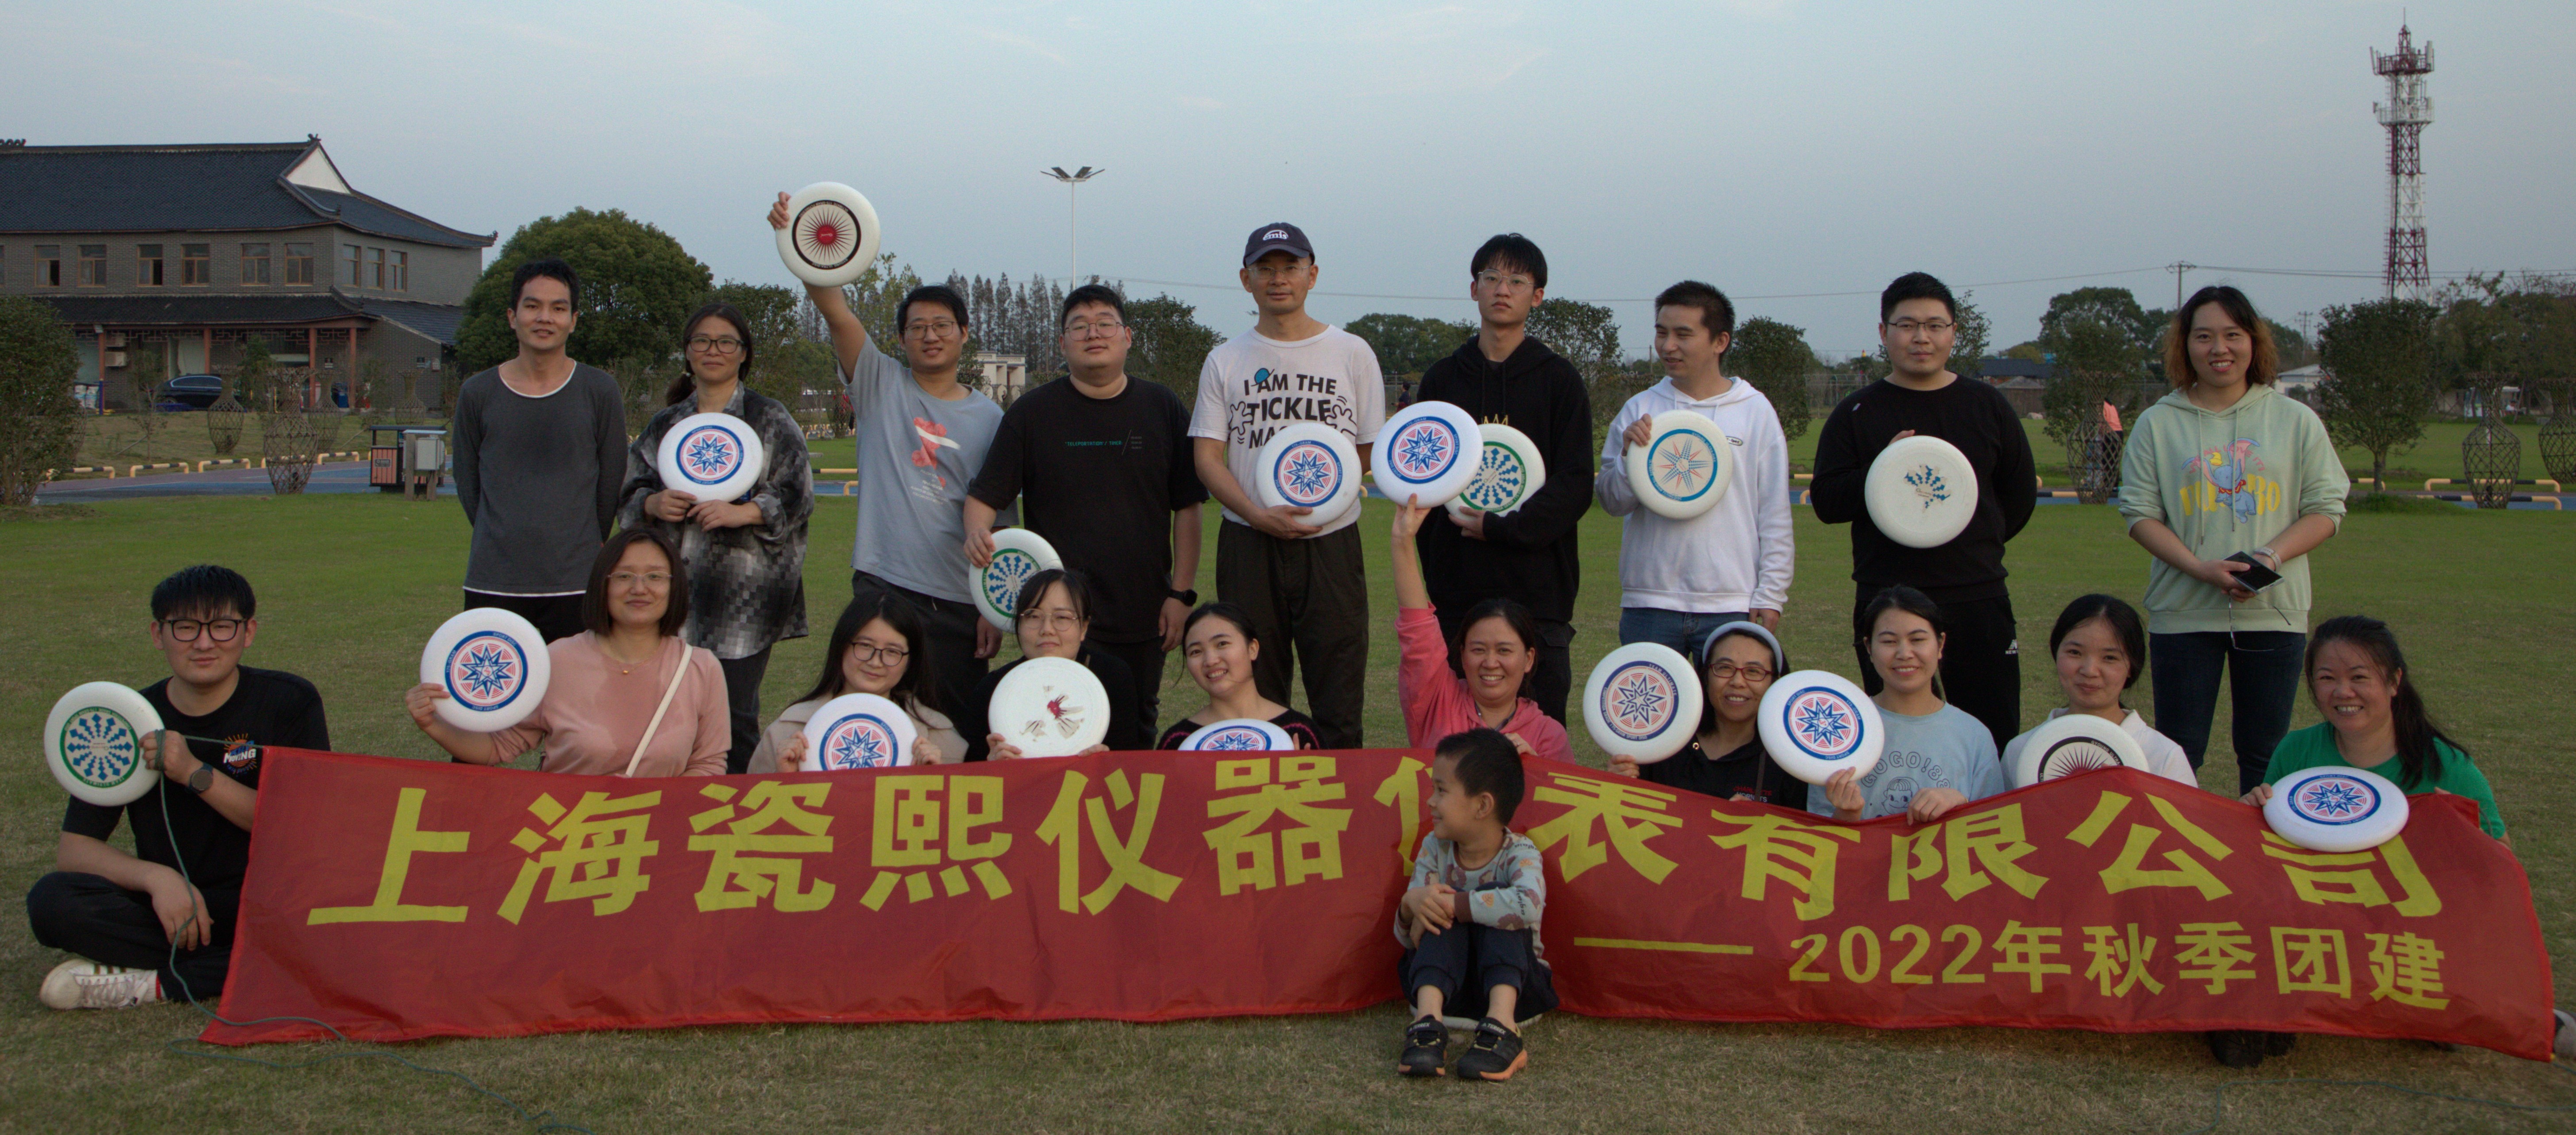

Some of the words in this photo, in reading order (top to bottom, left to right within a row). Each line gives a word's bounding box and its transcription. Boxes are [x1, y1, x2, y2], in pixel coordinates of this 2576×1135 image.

[1244, 380, 1249, 396] I
[1257, 374, 1288, 393] AM
[1296, 374, 1336, 395] THE
[1247, 397, 1330, 425] TICKLE
[1249, 426, 1287, 448] MA
[2180, 473, 2281, 516] DUBO
[493, 631, 508, 640] SPORT
[507, 637, 517, 646] DISC
[1650, 662, 1663, 671] TEAM
[1662, 669, 1678, 696] ULTIMATE
[1786, 694, 1797, 706] SPORT
[2091, 740, 2109, 752] GYOUNG
[223, 748, 256, 764] MOVING
[1733, 785, 1772, 796] CHARLTTE
[1486, 1023, 1506, 1035] TERREX
